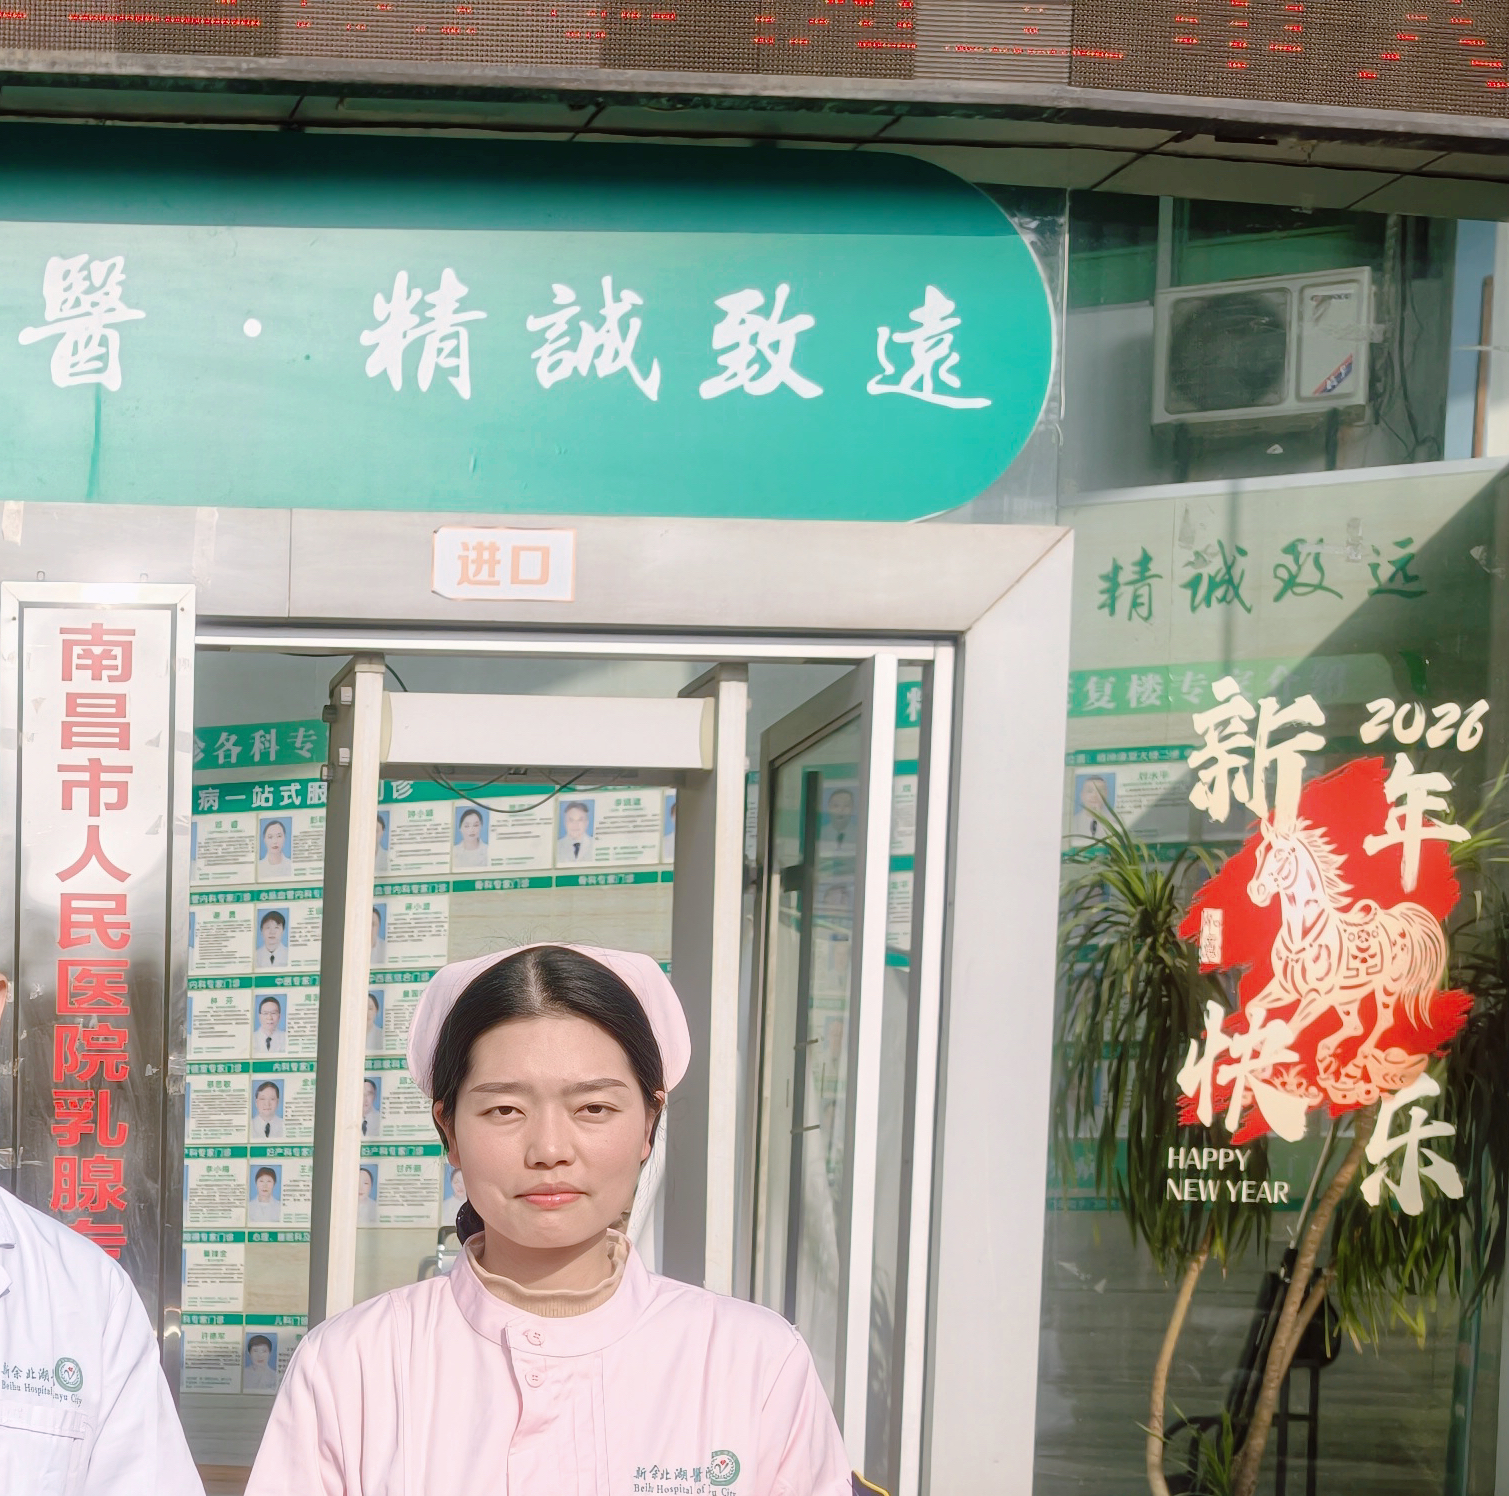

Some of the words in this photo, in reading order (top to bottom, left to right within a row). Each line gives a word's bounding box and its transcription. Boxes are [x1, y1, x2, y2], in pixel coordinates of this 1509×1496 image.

[455, 539, 551, 589] 进口
[1097, 537, 1429, 626] 精诚致远
[1067, 664, 1348, 712] 复楼专家介绍
[1359, 696, 1491, 752] 2026
[1166, 1145, 1252, 1172] HAPPY
[1165, 1176, 1219, 1202] NEW
[1226, 1178, 1291, 1206] YEAR
[24, 1382, 53, 1397] Hospital
[656, 1483, 693, 1496] Hospital
